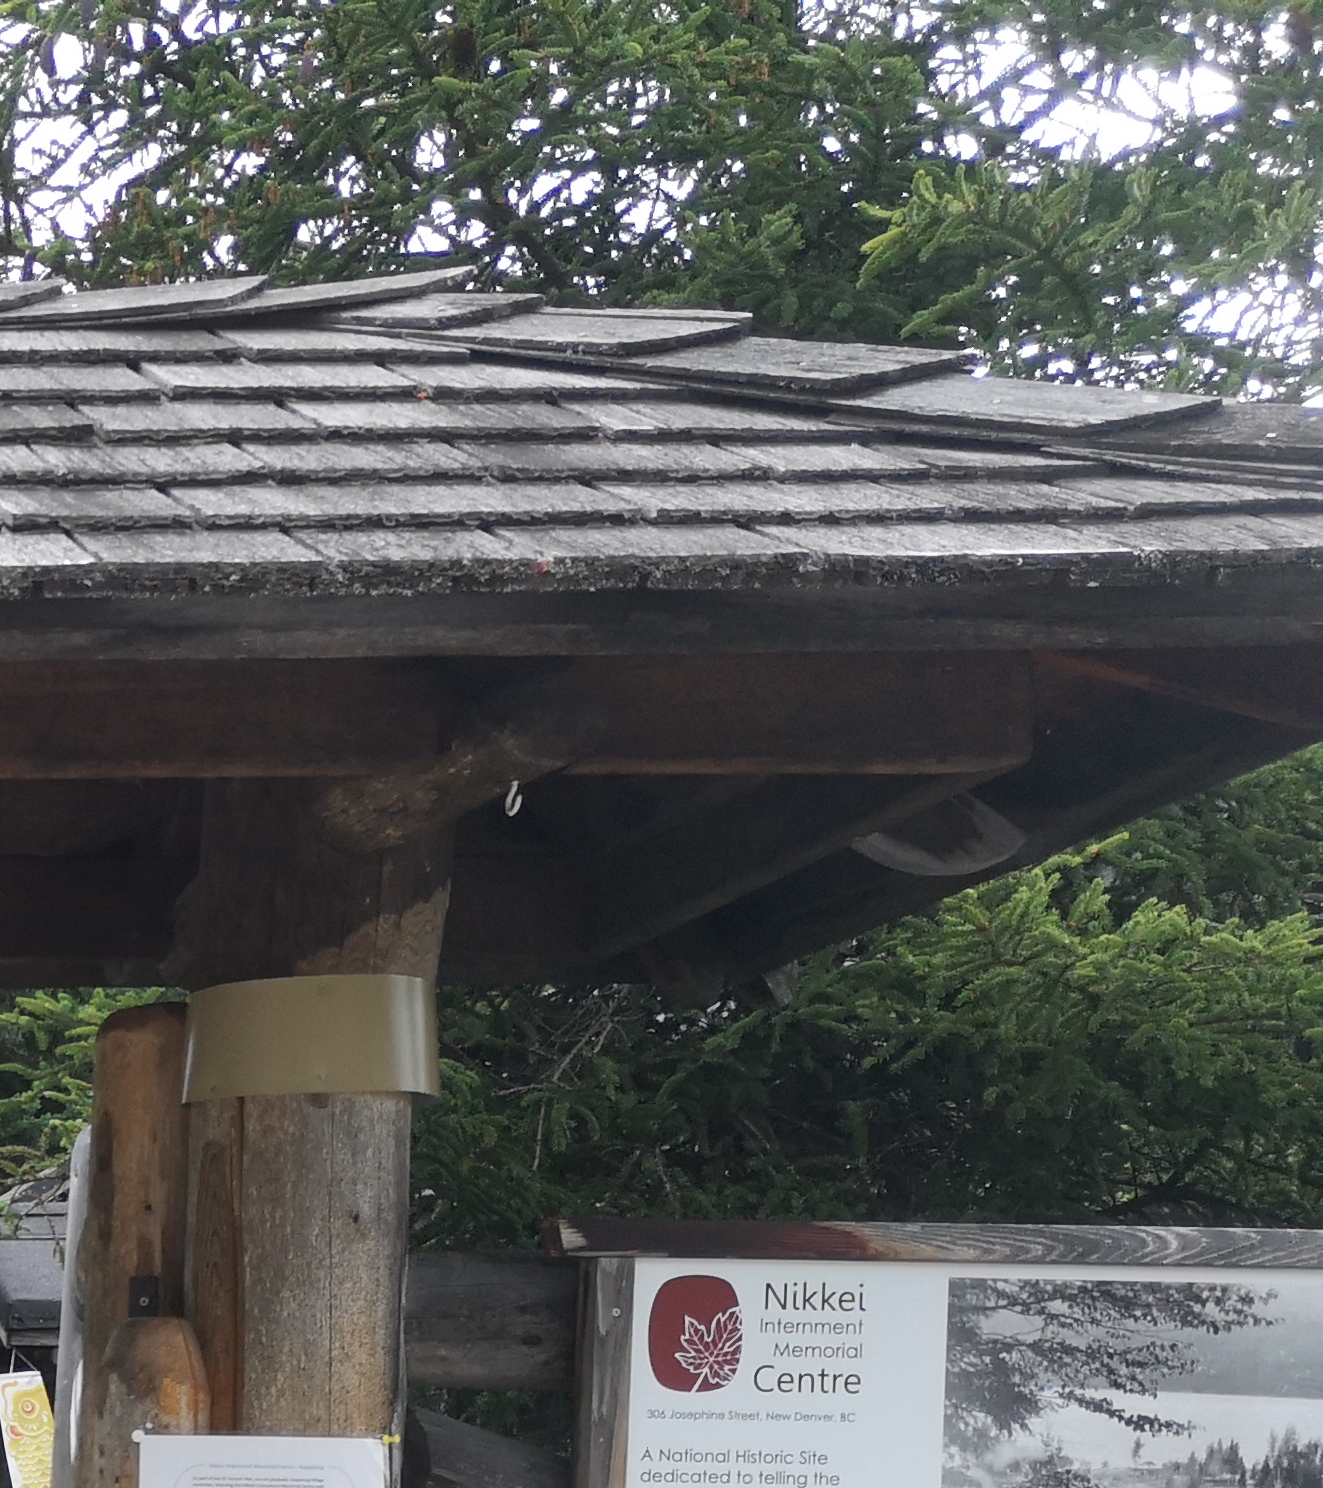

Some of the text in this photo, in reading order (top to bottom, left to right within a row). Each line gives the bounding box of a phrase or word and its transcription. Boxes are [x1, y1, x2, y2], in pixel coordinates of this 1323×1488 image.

[764, 1282, 866, 1312] Nikkei
[760, 1318, 863, 1335] Internment
[773, 1342, 863, 1358] Memorial
[753, 1365, 861, 1394] Centre
[647, 1410, 666, 1419] 306
[669, 1410, 725, 1421] Josephine
[728, 1410, 763, 1421] Street,
[766, 1412, 790, 1421] New
[840, 1413, 856, 1422] BC
[640, 1449, 828, 1465] A National Historic Site
[640, 1468, 840, 1488] dedicated to telling the
